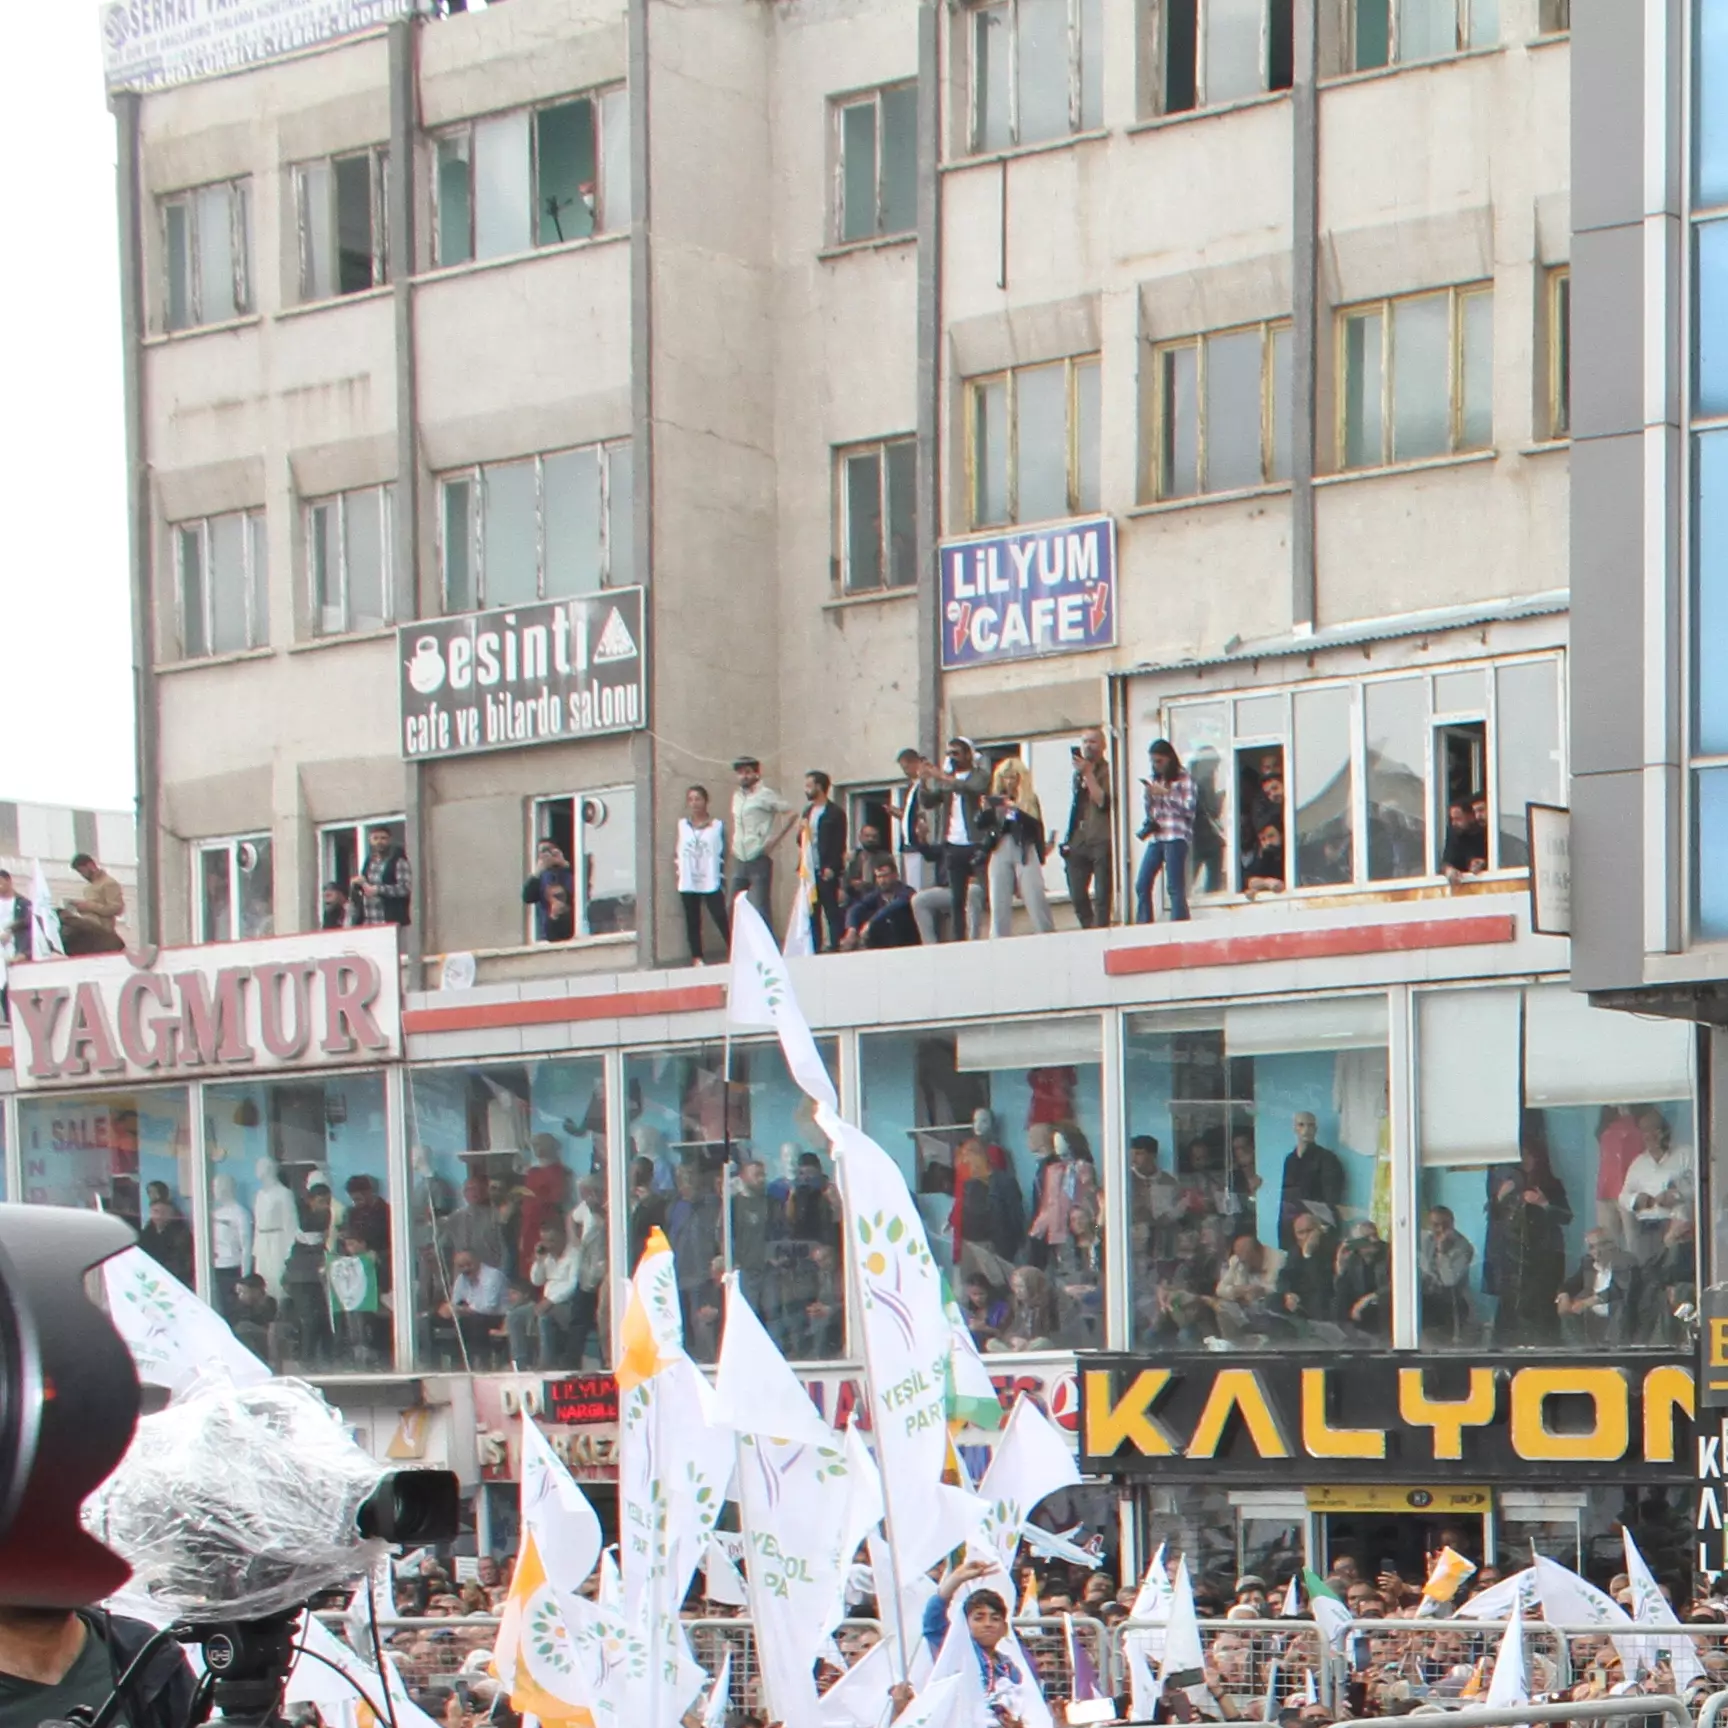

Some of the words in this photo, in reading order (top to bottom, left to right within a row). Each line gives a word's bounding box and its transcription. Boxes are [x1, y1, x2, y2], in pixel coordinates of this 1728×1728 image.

[970, 593, 1085, 653] CAFE
[406, 702, 449, 754] cafe
[456, 707, 479, 747] ve
[486, 686, 561, 743] bilardo
[569, 678, 638, 731] salonu
[8, 945, 391, 1078] YAĞMUR
[51, 1116, 108, 1152] SALE
[880, 1370, 930, 1412] YEŞİL
